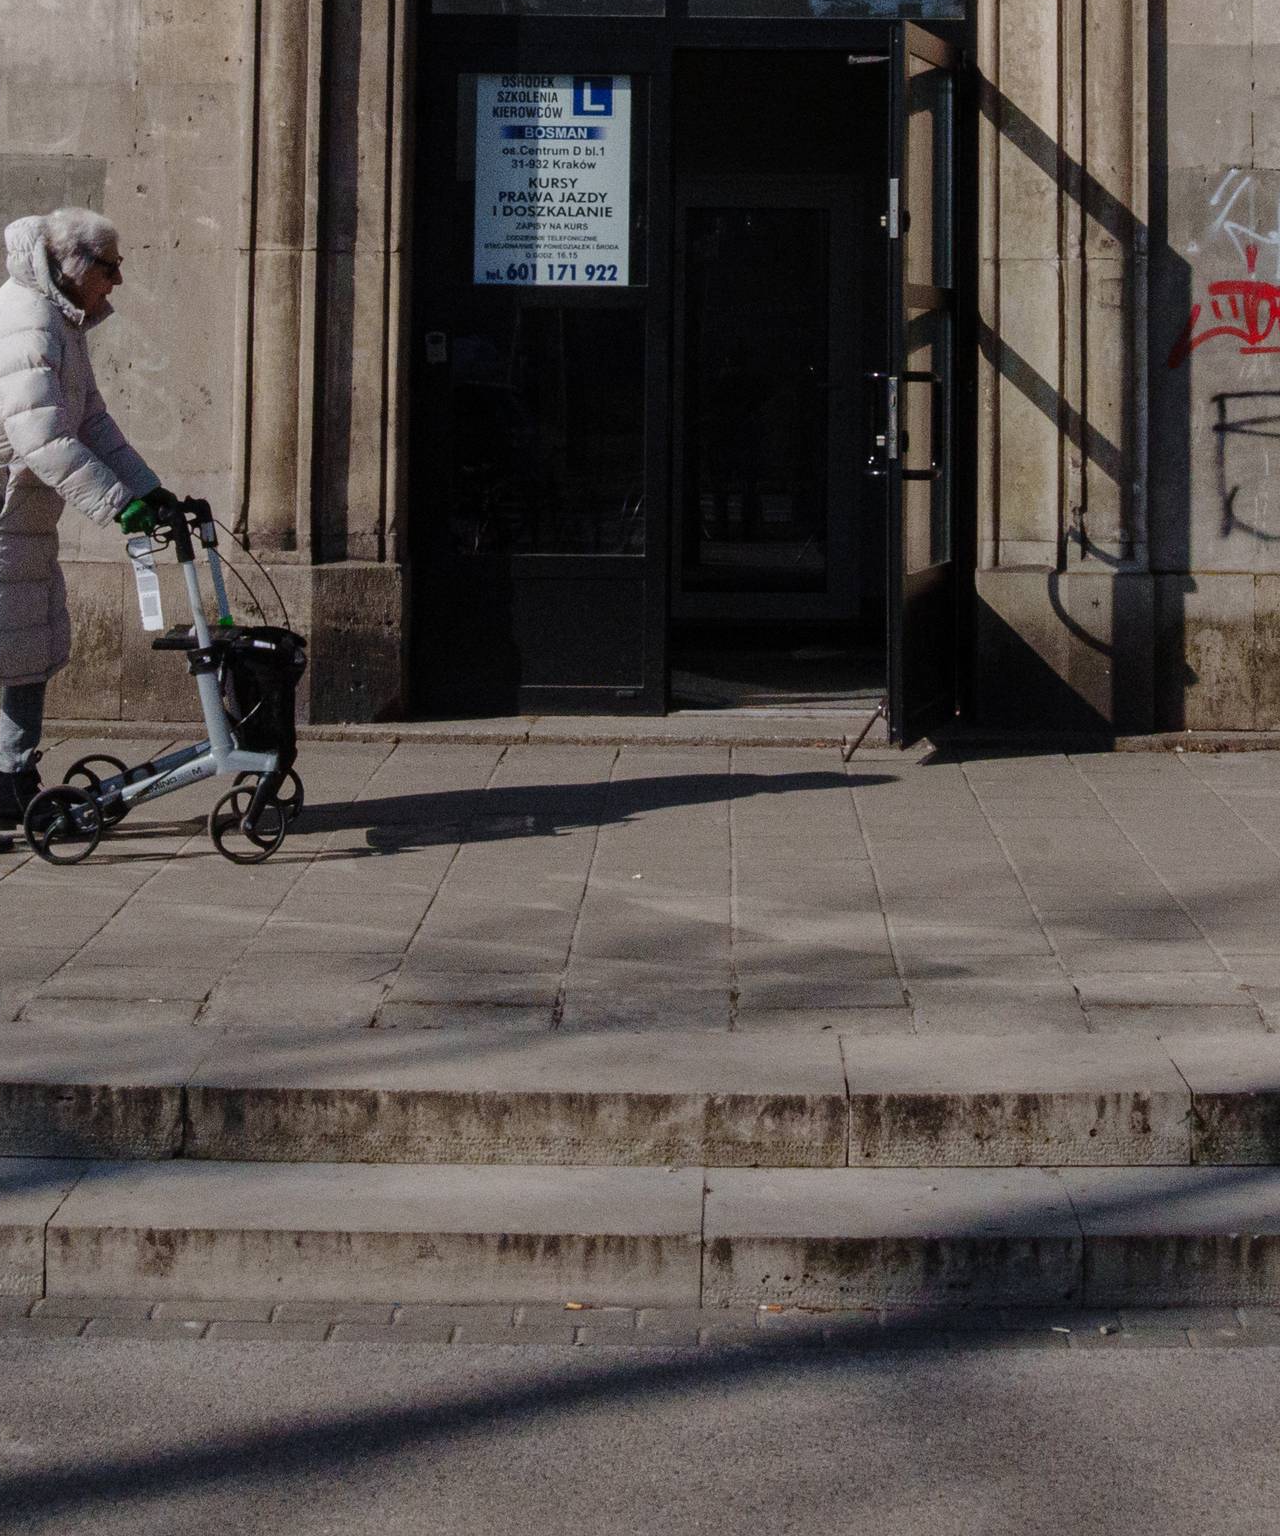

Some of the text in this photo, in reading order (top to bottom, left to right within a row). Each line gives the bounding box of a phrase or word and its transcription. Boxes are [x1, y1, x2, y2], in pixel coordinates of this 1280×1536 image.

[497, 91, 558, 103] SZKOLENIA
[583, 82, 605, 111] L
[492, 105, 563, 118] KIEROWCÓW
[524, 127, 588, 139] BOSMAN
[573, 146, 582, 156] D
[585, 145, 605, 156] bl.1
[511, 159, 597, 169] 31-932 Kraków
[528, 177, 578, 188] KURSY
[498, 191, 608, 203] PRAWA JAZDY
[492, 206, 613, 218] I DOSZKALANIE
[515, 222, 589, 231] ZAPISY NA KURS
[507, 264, 537, 281] 601
[548, 264, 576, 281] 171
[585, 264, 618, 281] 922
